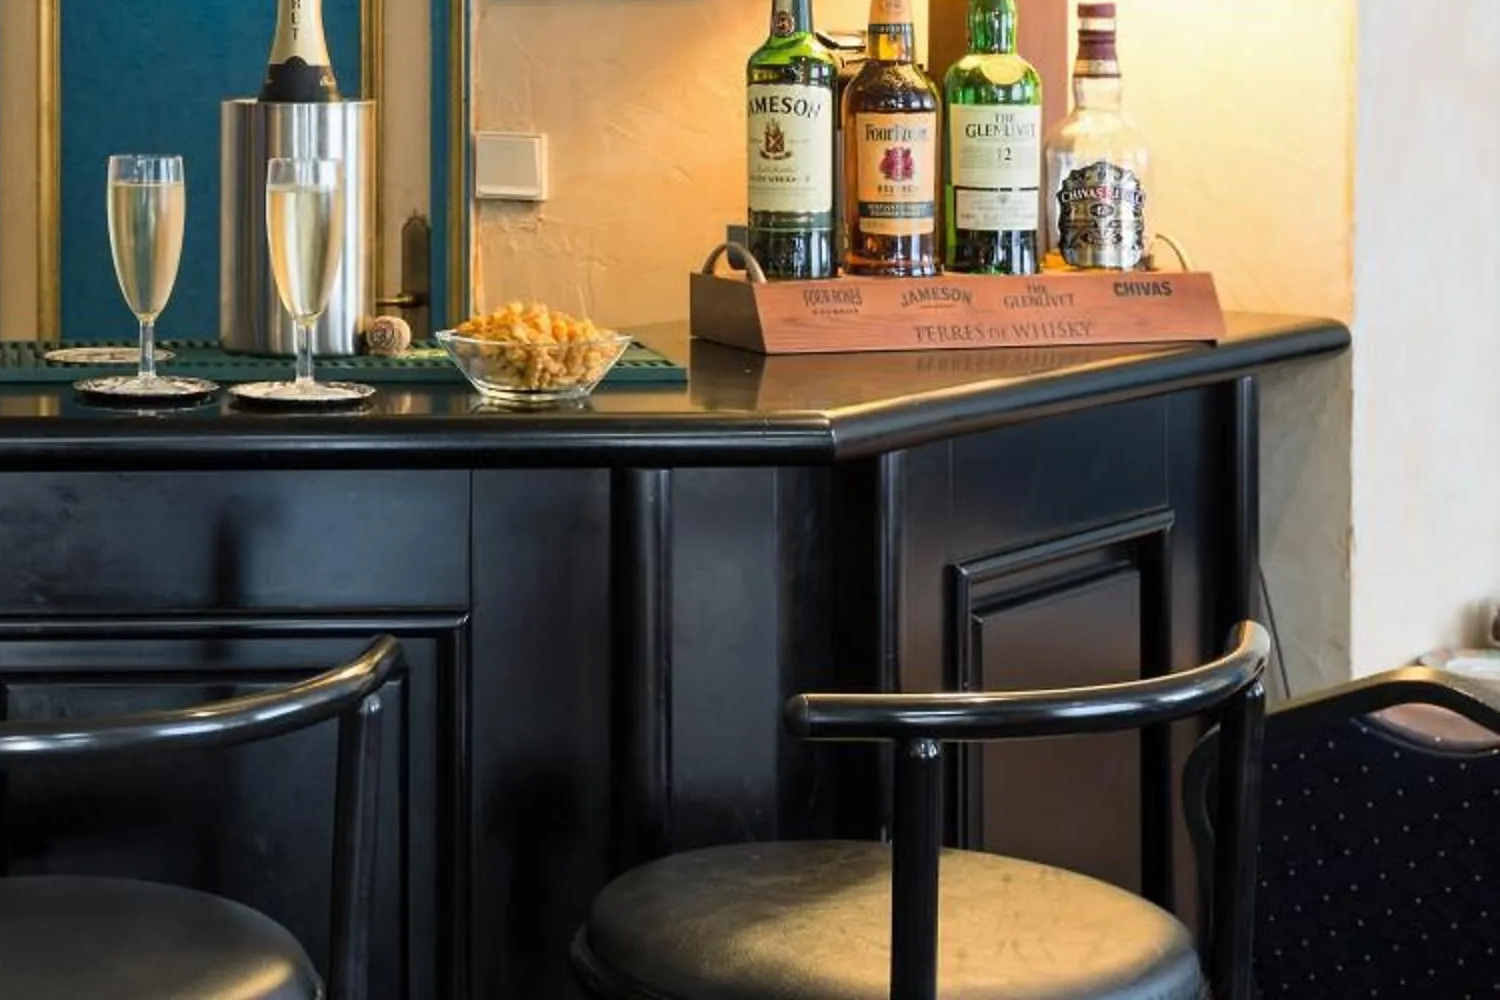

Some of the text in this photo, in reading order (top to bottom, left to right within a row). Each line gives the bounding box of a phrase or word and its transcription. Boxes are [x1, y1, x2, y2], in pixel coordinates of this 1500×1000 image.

[965, 124, 1036, 138] GLENLIVT
[900, 286, 973, 309] JAMESON
[1113, 281, 1173, 297] CHIVAS
[912, 323, 986, 343] TERRES
[1011, 320, 1094, 340] WHISKY
